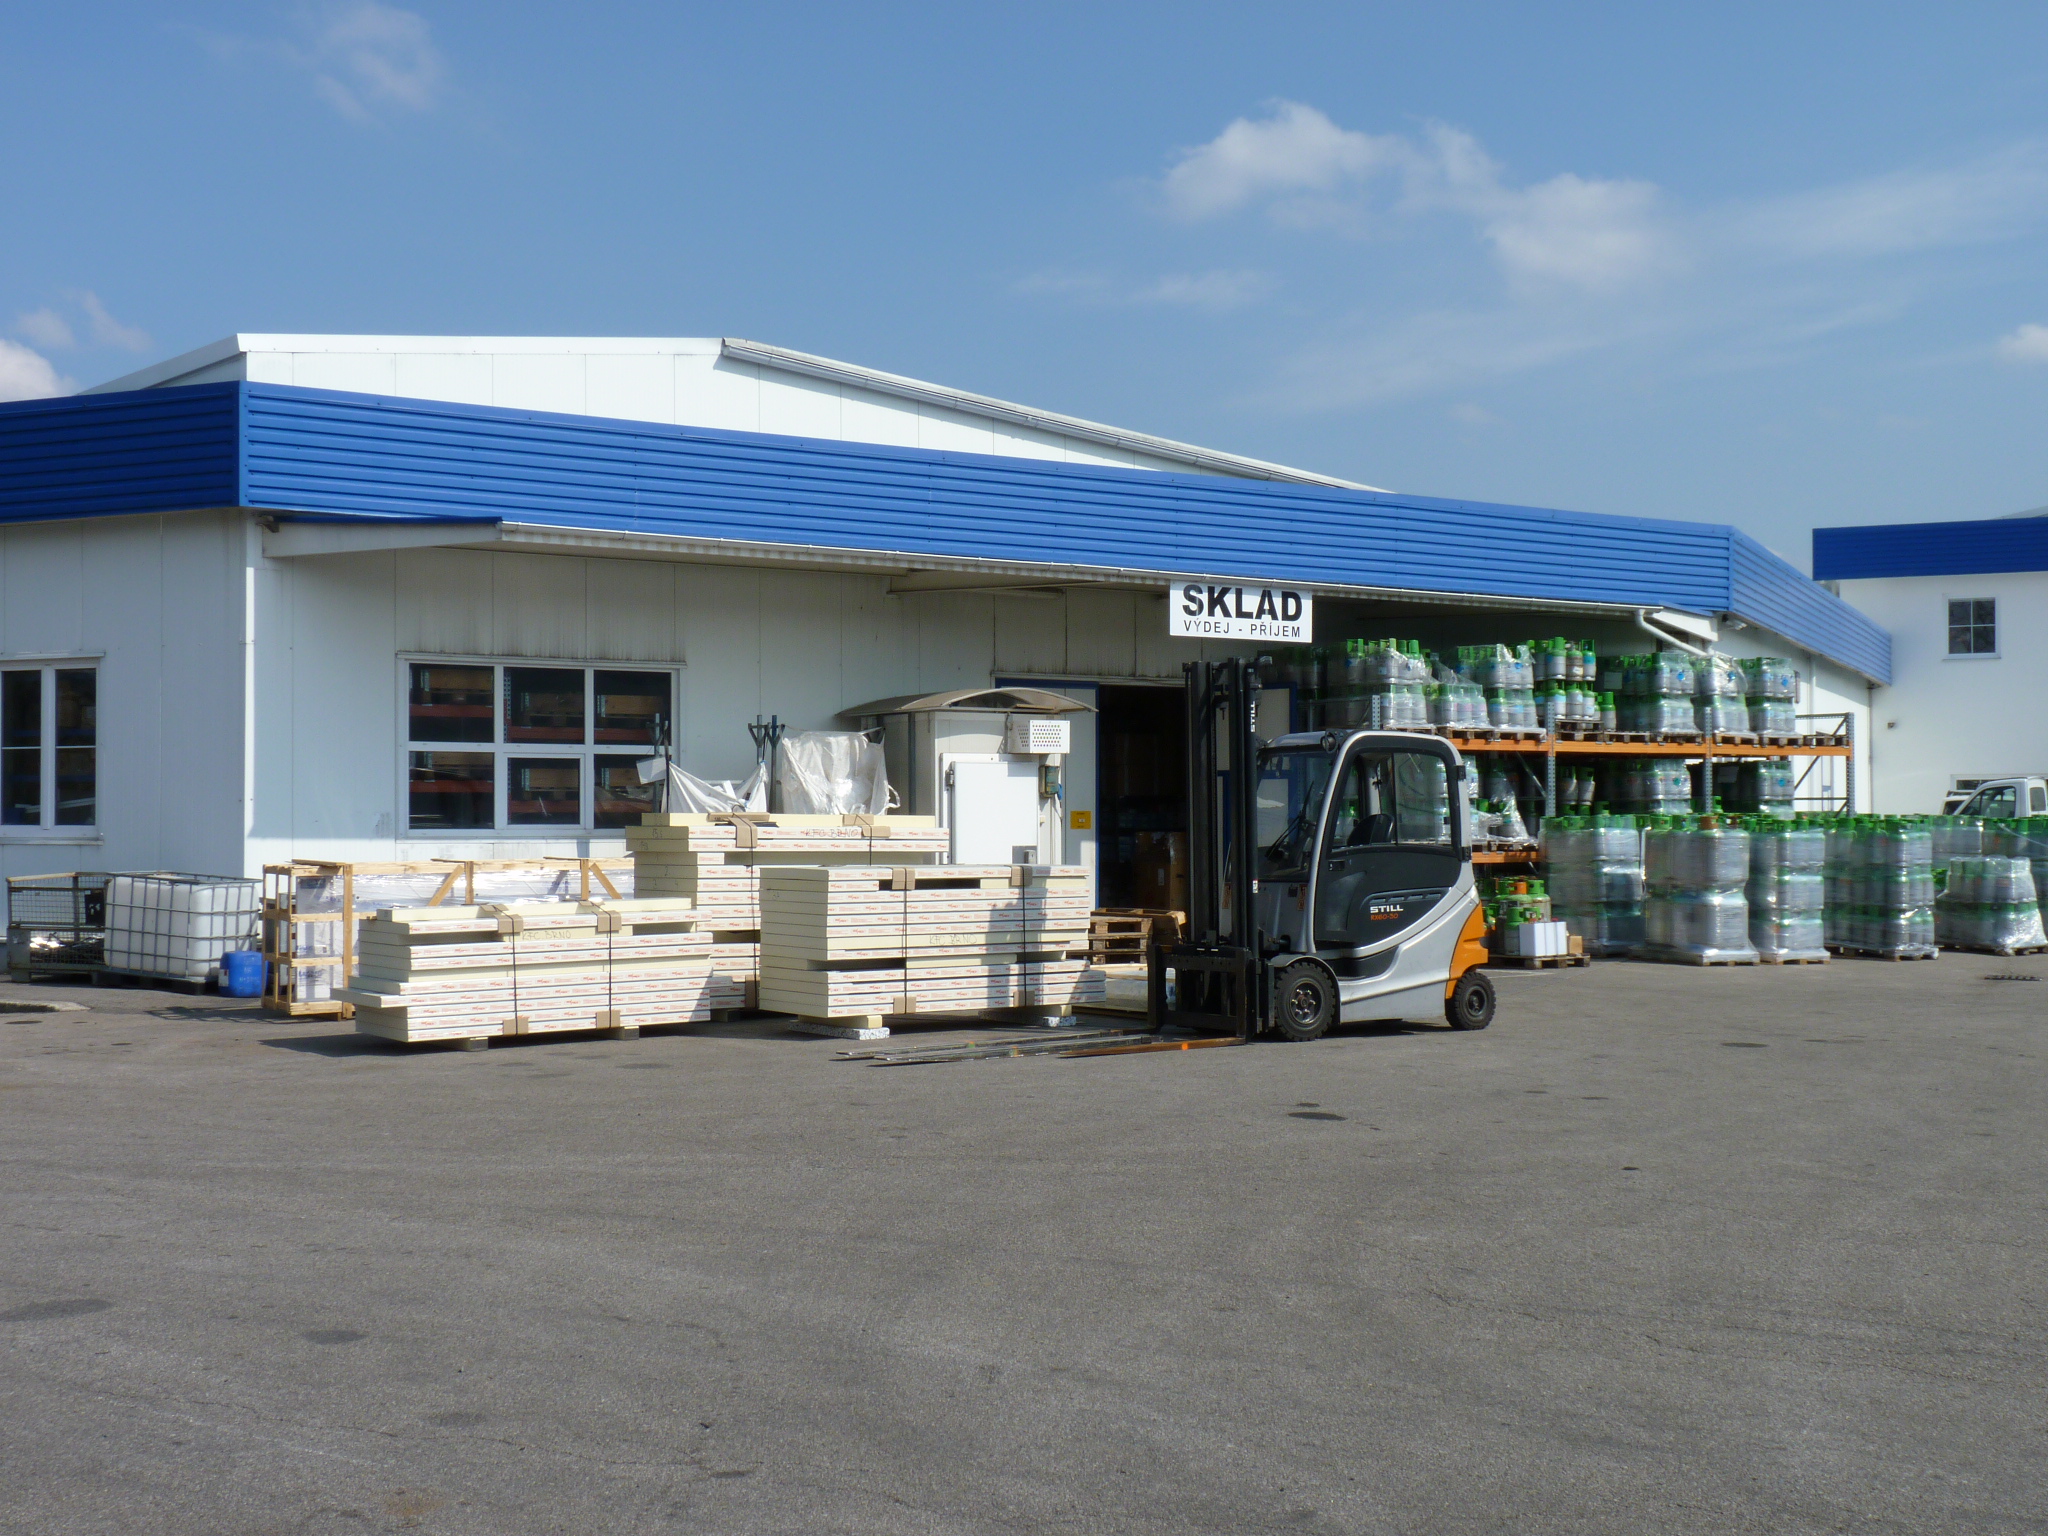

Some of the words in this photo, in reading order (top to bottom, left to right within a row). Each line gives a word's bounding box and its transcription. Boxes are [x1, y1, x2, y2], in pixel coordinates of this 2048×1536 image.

[1182, 584, 1303, 622] SKLAD
[1183, 618, 1230, 634] VÝDEJ
[1250, 621, 1300, 638] PŘÍJEM
[1370, 904, 1403, 912] STILL
[544, 930, 572, 940] BRNO
